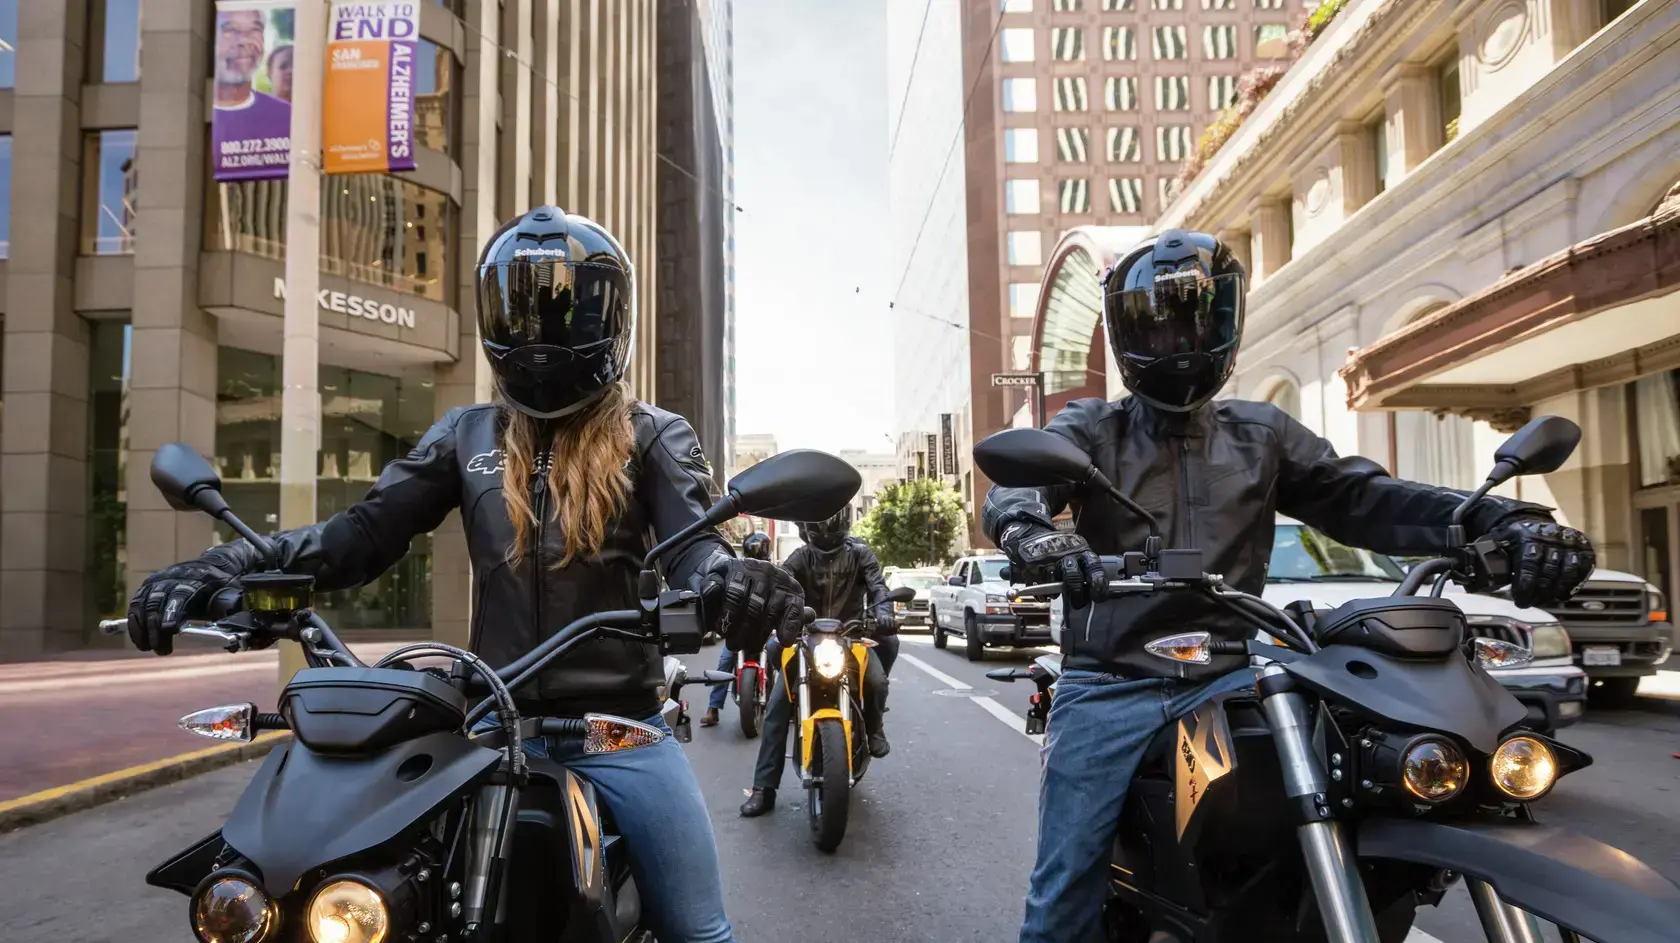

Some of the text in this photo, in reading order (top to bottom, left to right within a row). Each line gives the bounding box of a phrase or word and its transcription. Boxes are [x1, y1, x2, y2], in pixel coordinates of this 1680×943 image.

[338, 4, 413, 18] WALK TO
[335, 18, 413, 40] END
[332, 48, 361, 60] SAN
[391, 43, 412, 158] ALZHEIMER'S
[514, 248, 565, 257] Schuberth
[1154, 269, 1200, 283] Schuberth
[274, 277, 415, 329] MKESSON
[995, 376, 1036, 386] CROCKER
